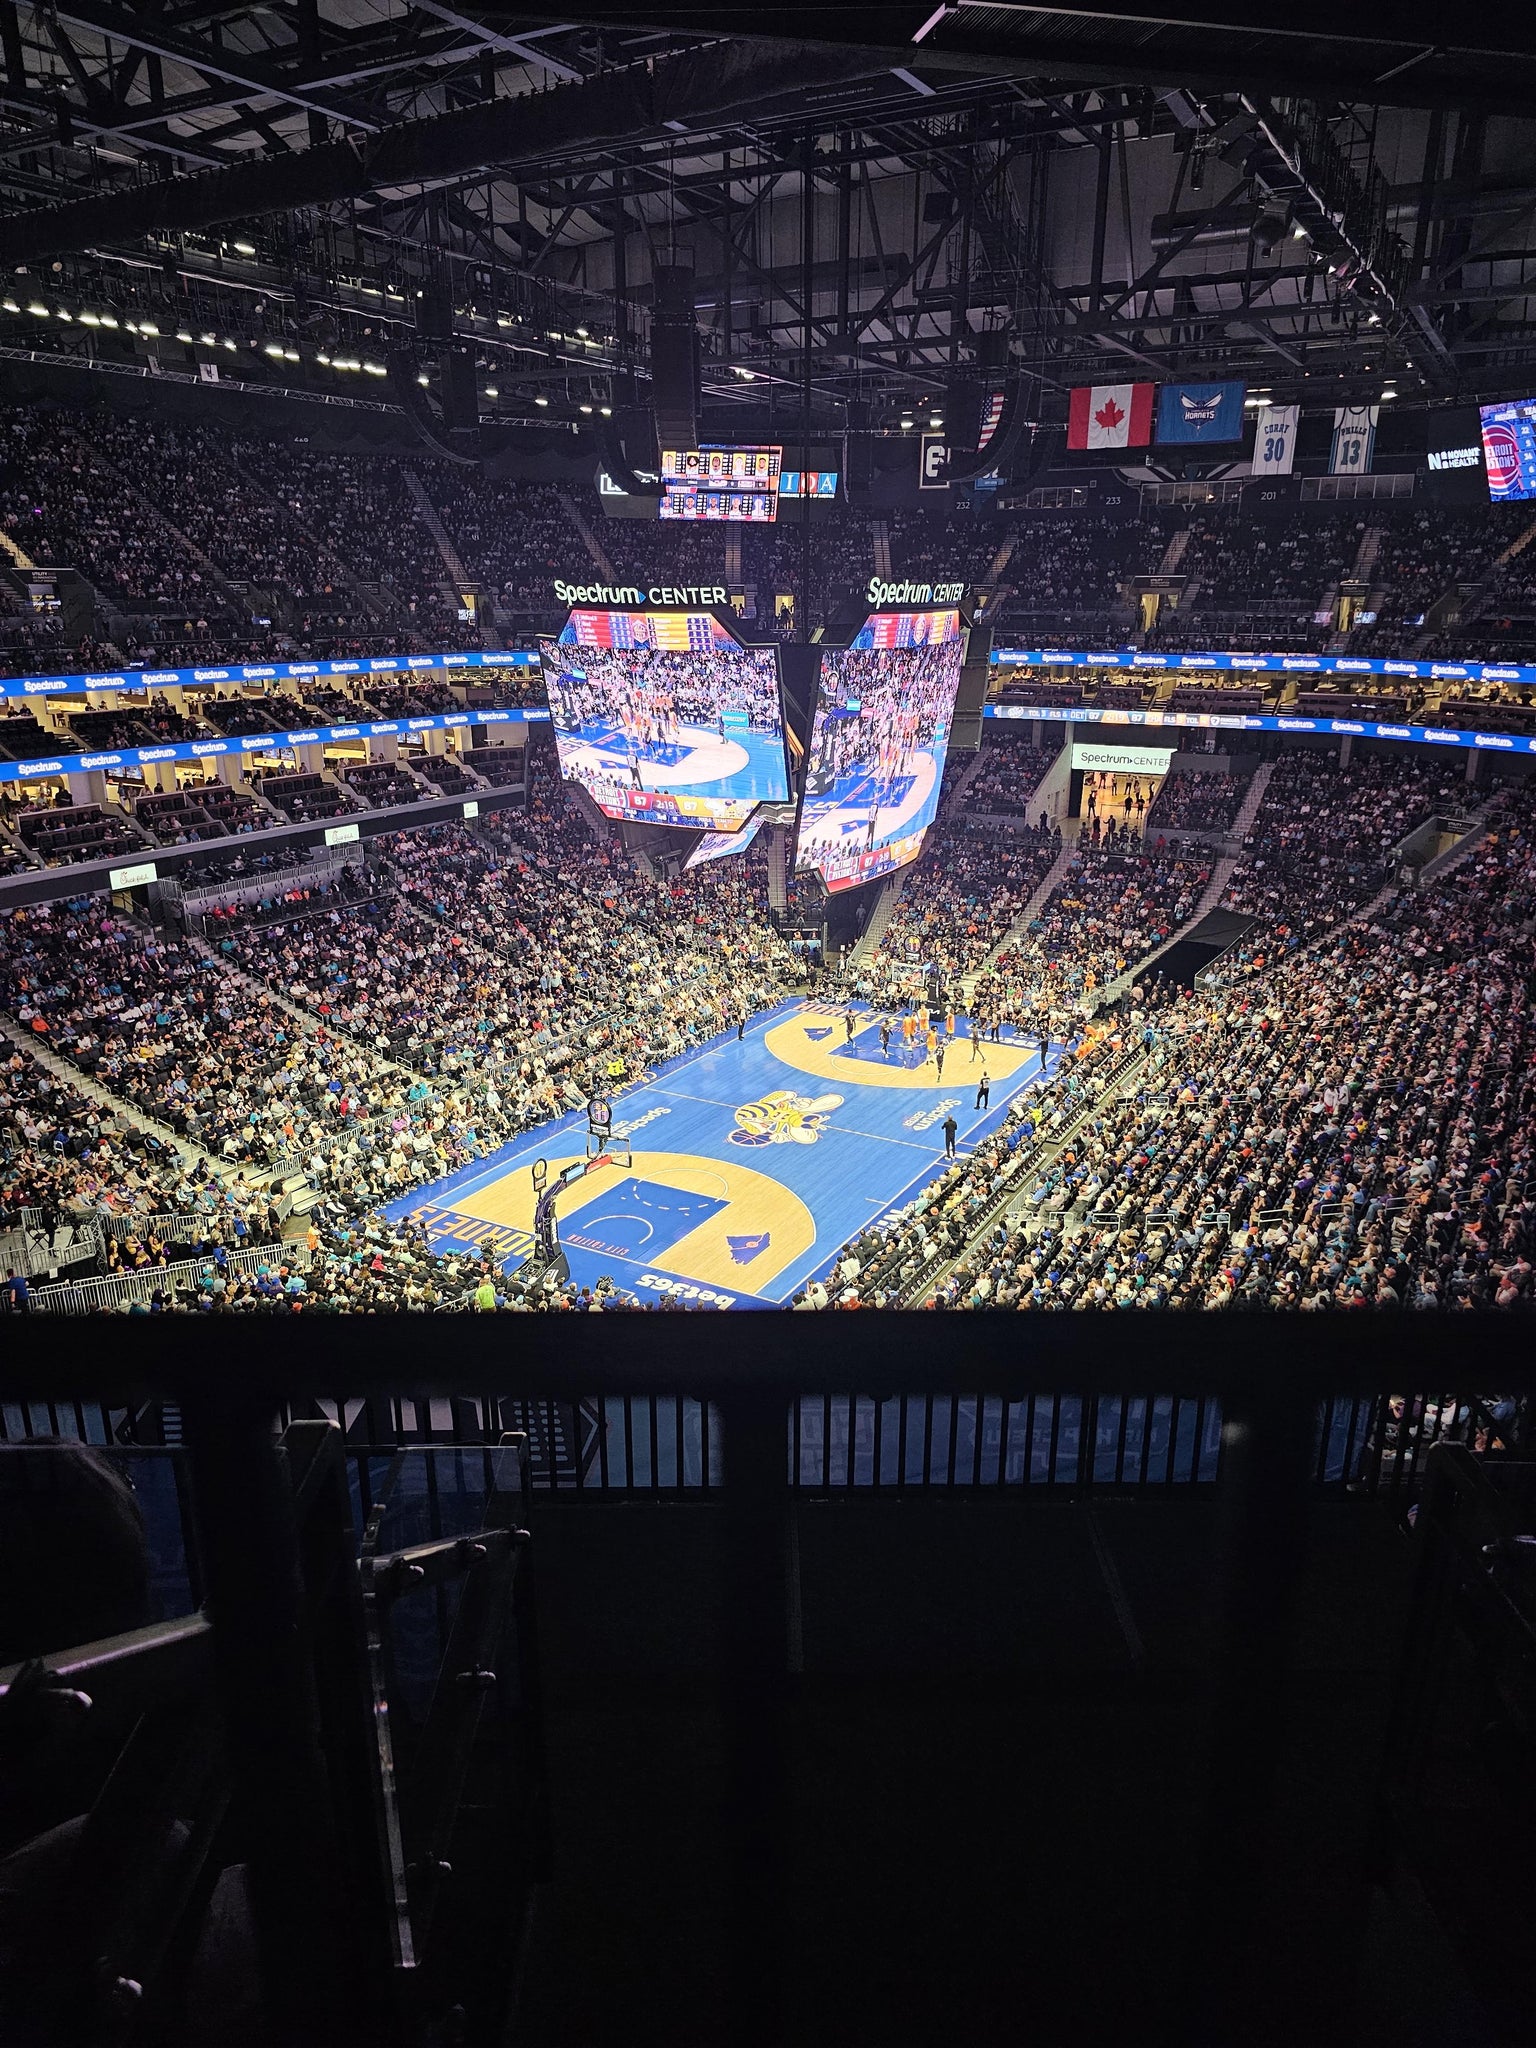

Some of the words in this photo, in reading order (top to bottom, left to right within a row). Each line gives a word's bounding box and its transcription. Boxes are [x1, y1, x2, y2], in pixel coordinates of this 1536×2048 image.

[1184, 410, 1215, 420] HORNETS
[1264, 423, 1290, 434] CURRY
[1341, 426, 1367, 436] PHILLS
[1264, 438, 1285, 462] 30
[1340, 439, 1361, 465] 13
[1447, 447, 1480, 459] NOVANT
[1485, 443, 1513, 458] ETROIT
[1449, 457, 1479, 468] HEALTH
[1486, 455, 1515, 471] ISTONS
[1105, 496, 1121, 505] 233
[1261, 491, 1276, 501] 201
[956, 502, 970, 510] 232
[554, 579, 640, 606] Spectrum
[648, 587, 727, 605] CENTER
[867, 576, 931, 610] Spectrum
[933, 582, 965, 602] CENTER
[408, 658, 431, 668] Spectrum
[443, 656, 466, 666] Spectrum
[482, 655, 512, 664] Spectrum
[999, 654, 1027, 662] Spectrum
[1042, 654, 1071, 662] Spectrum
[1087, 655, 1117, 664] Spectrum
[1133, 656, 1165, 665] Spectrum
[1182, 657, 1214, 666] Spectrum
[1231, 658, 1264, 667] Spectrum
[1283, 658, 1317, 668] Spectrum
[289, 665, 316, 676] Spectrum
[331, 663, 357, 673] Spectrum
[371, 661, 395, 670] Spectrum
[1336, 660, 1369, 670] Spectrum
[1384, 661, 1416, 672] Spectrum
[1431, 665, 1464, 675] Spectrum
[194, 670, 227, 681] Spectrum
[243, 668, 273, 678] Spectrum
[1482, 667, 1517, 678] Spectrum
[85, 677, 122, 688] Spectrum
[142, 673, 176, 685] Spectrum
[24, 681, 64, 693] Spectrum
[444, 716, 466, 726] Spectrum
[478, 712, 507, 721] Spectrum
[1070, 711, 1085, 719] DET
[1131, 714, 1143, 722] 87
[371, 724, 396, 735] Spectrum
[409, 720, 432, 730] Spectrum
[1278, 719, 1312, 729] Spectrum
[1332, 721, 1362, 732] Spectrum
[331, 728, 357, 739] Spectrum
[1377, 726, 1409, 737] Spectrum
[1424, 730, 1457, 742] Spectrum
[242, 738, 272, 749] Spectrum
[288, 733, 317, 744] Spectrum
[1475, 735, 1510, 747] Spectrum
[192, 743, 225, 755] Spectrum
[138, 749, 173, 761] Spectrum
[1081, 752, 1130, 763] Spectrum
[80, 755, 118, 768] Spectrum
[18, 762, 59, 775] Spectrum
[634, 795, 647, 806] 87
[656, 800, 675, 810] 2:19
[683, 801, 698, 811] 87
[408, 1206, 536, 1260] HORNETS
[566, 1234, 606, 1250] EDITION
[605, 1245, 630, 1256] CITY
[635, 1274, 737, 1311] bet365
